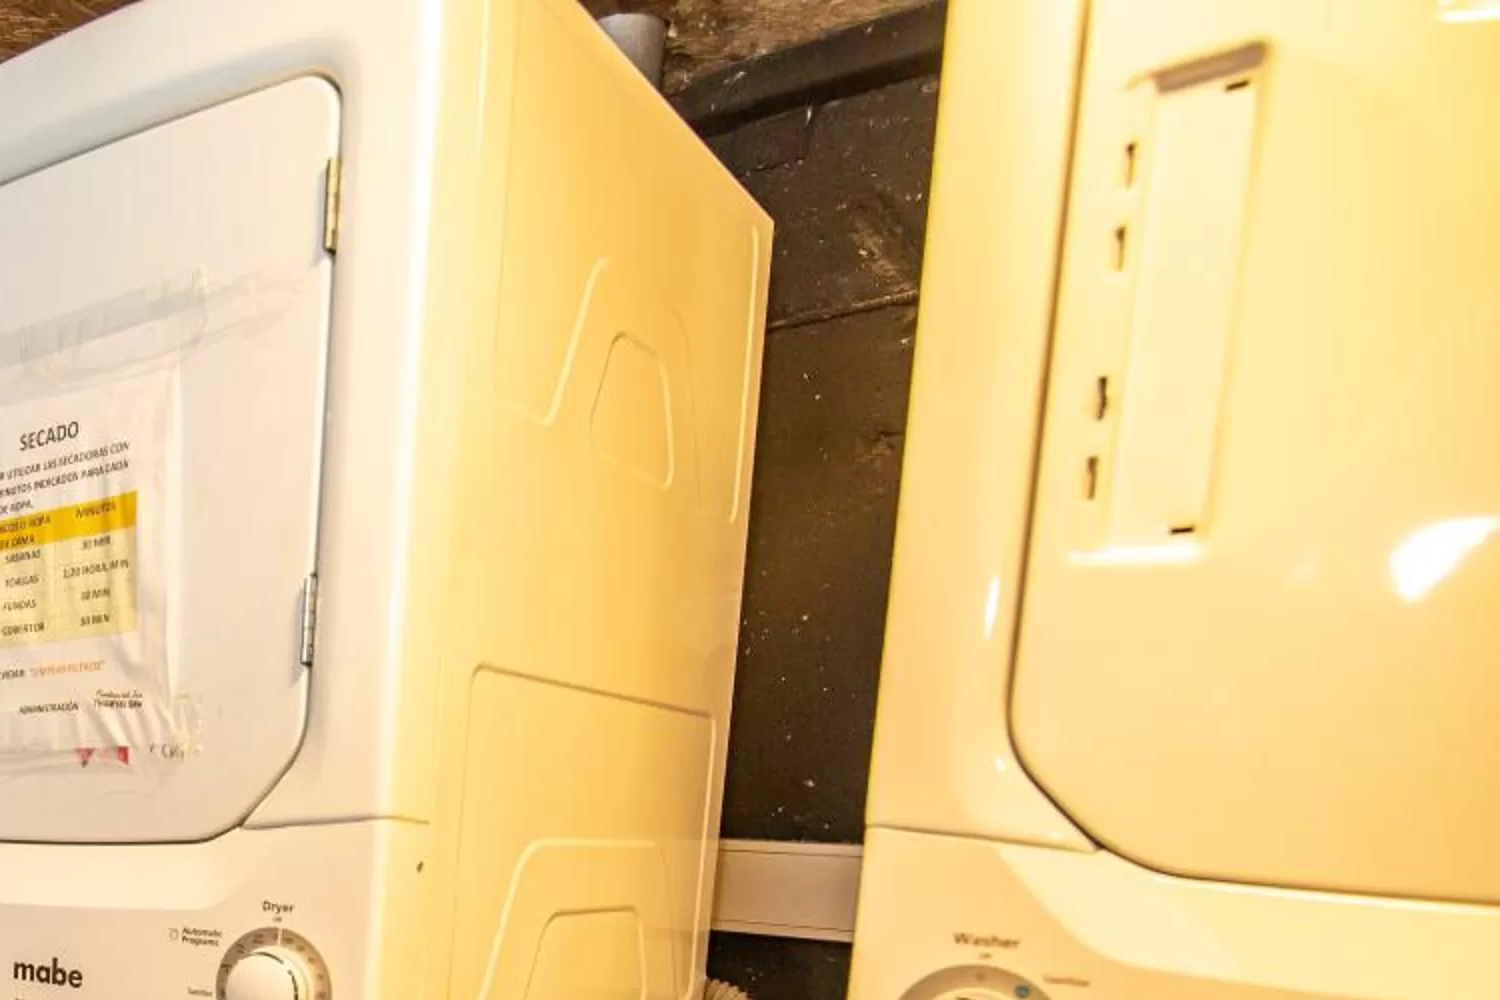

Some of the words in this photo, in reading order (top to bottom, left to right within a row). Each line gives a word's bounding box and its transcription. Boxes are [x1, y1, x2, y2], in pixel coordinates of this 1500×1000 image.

[20, 421, 79, 451] SECADO
[7, 463, 41, 480] UTILIZAR
[58, 448, 108, 467] SECADORAS
[110, 441, 130, 455] CON
[34, 472, 79, 490] INDICADOS
[81, 465, 104, 479] PARA
[105, 459, 129, 473] CADA
[76, 500, 116, 519] MINUTOS
[262, 900, 294, 914] Dryer
[953, 932, 1022, 950] Washer
[13, 957, 83, 989] mabe
